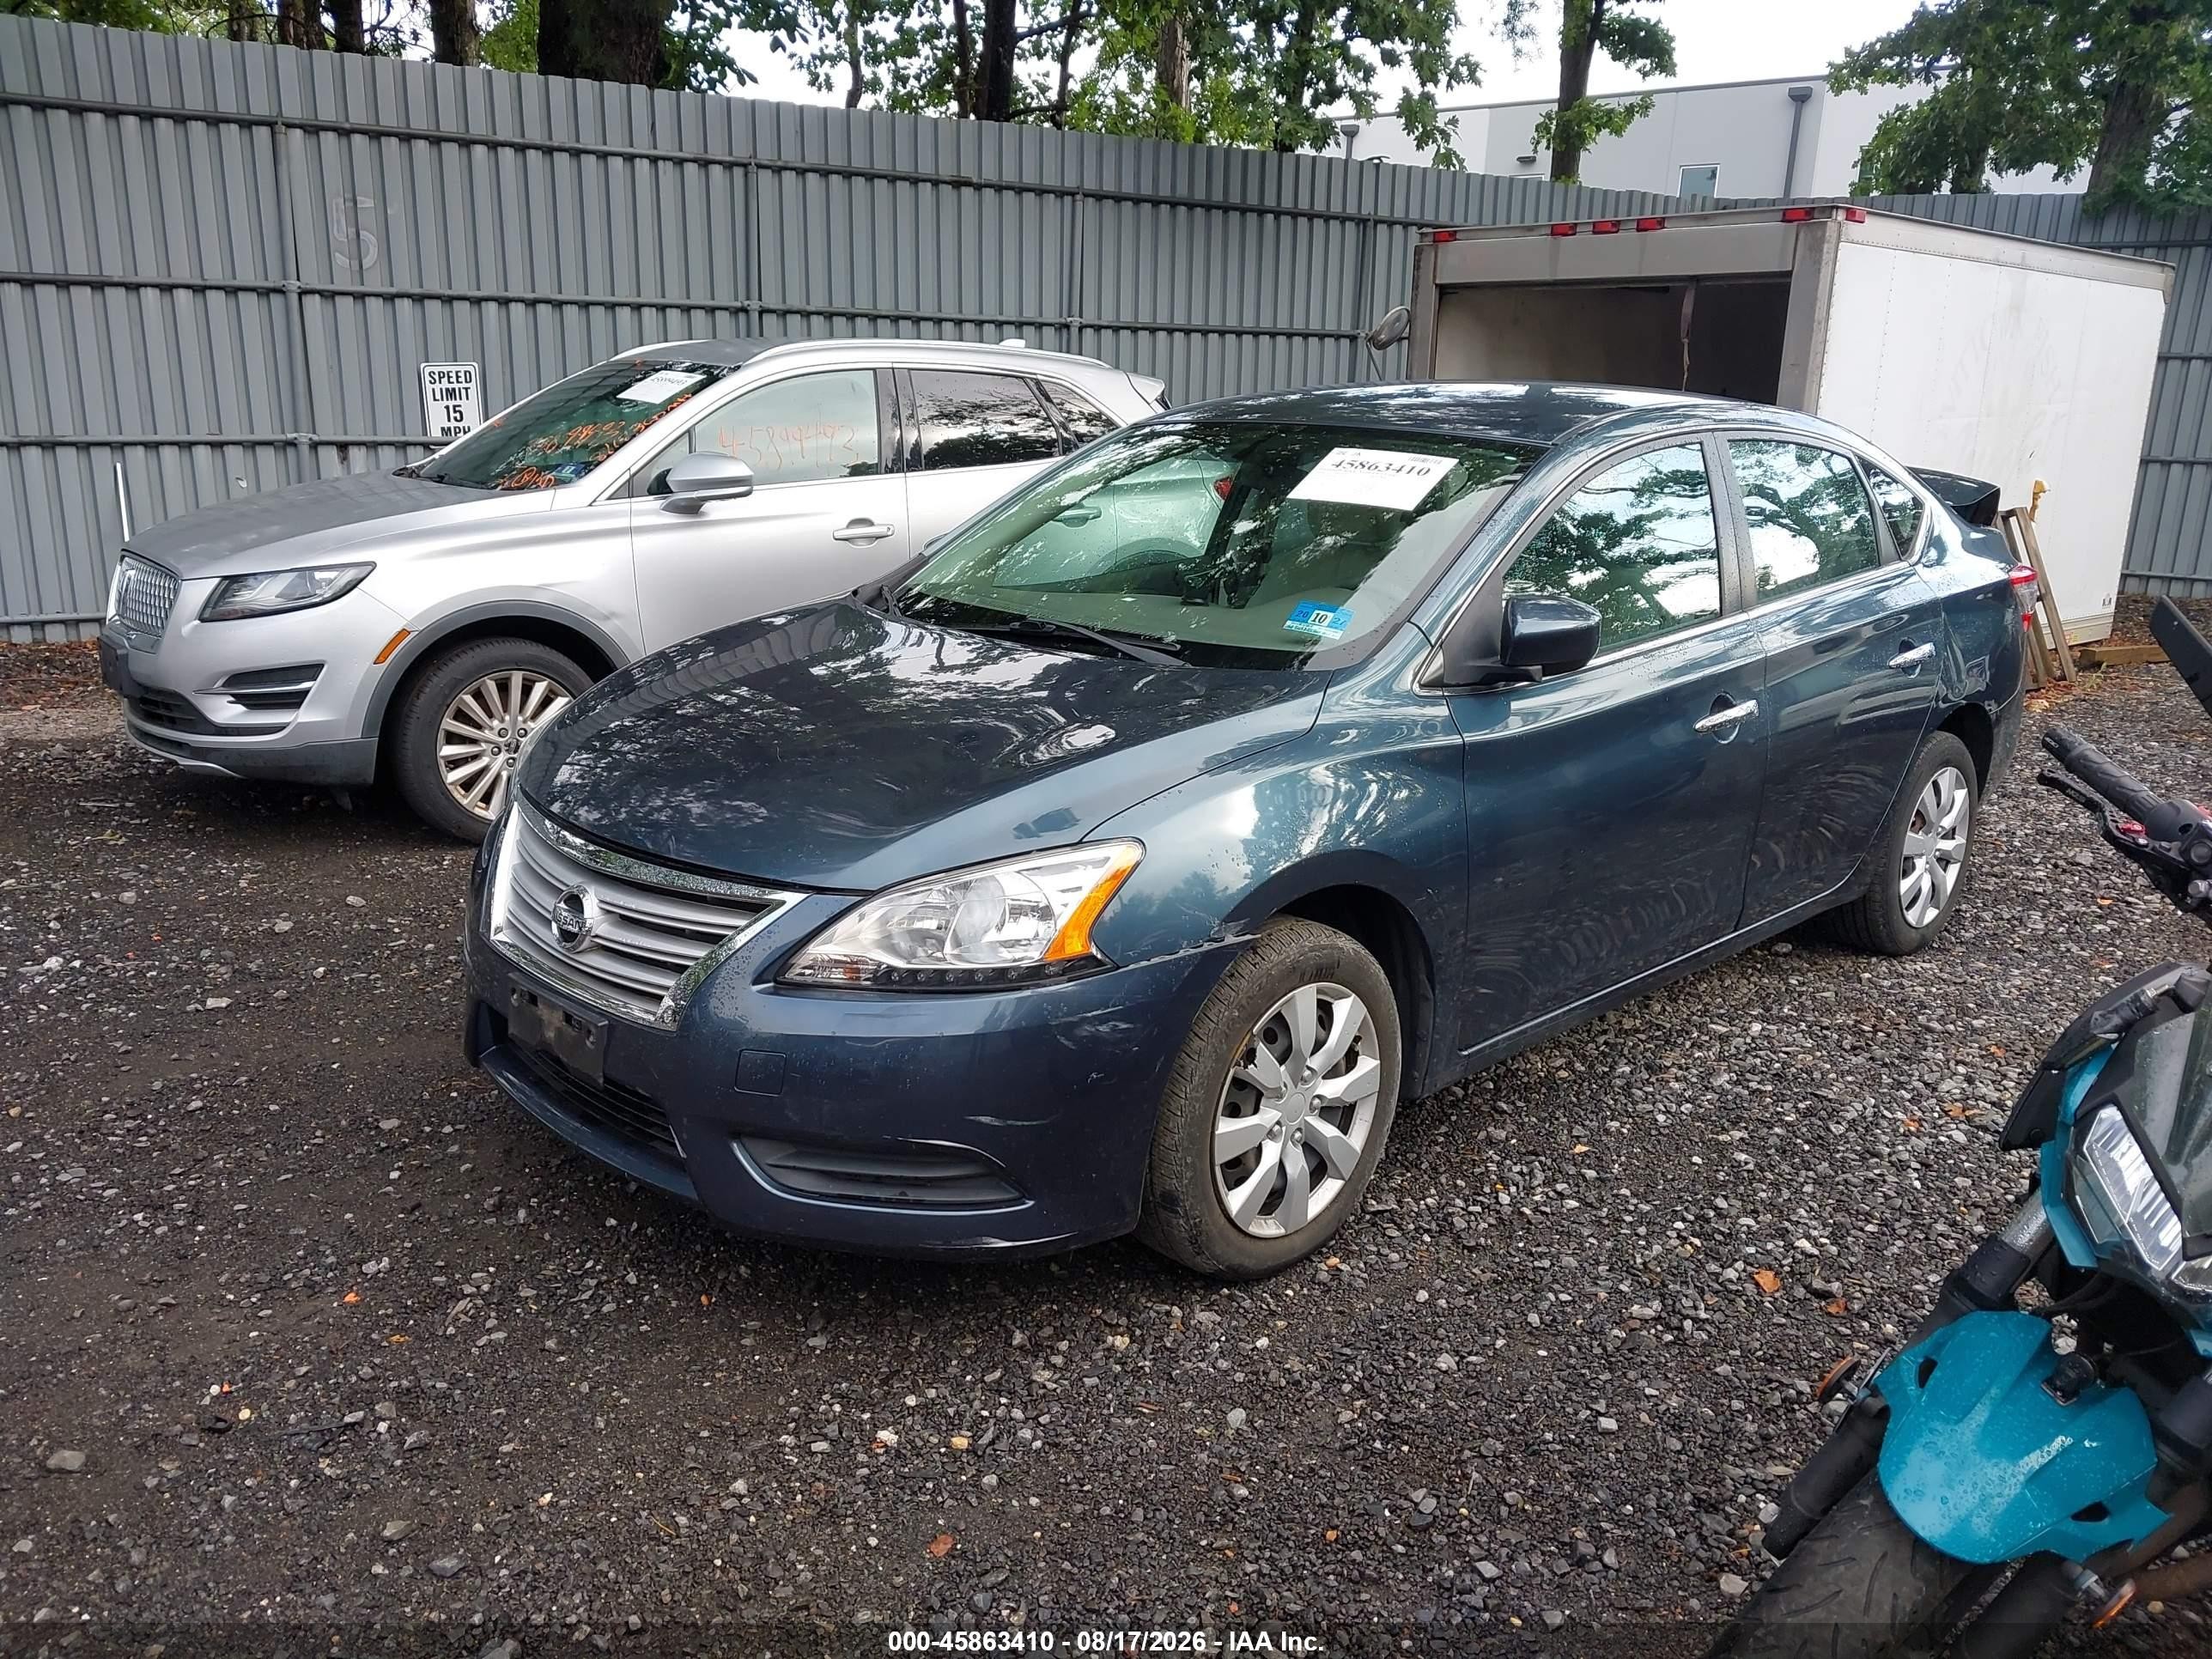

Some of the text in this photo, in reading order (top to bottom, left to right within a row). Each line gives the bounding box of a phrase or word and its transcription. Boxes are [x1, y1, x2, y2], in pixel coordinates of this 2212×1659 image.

[428, 370, 472, 385] SPEED
[432, 387, 471, 401] LIMIT
[444, 404, 464, 422] 15
[441, 426, 471, 436] MPH
[1331, 459, 1431, 477] 45863410
[1296, 610, 1310, 618] 20
[1311, 612, 1328, 624] 10
